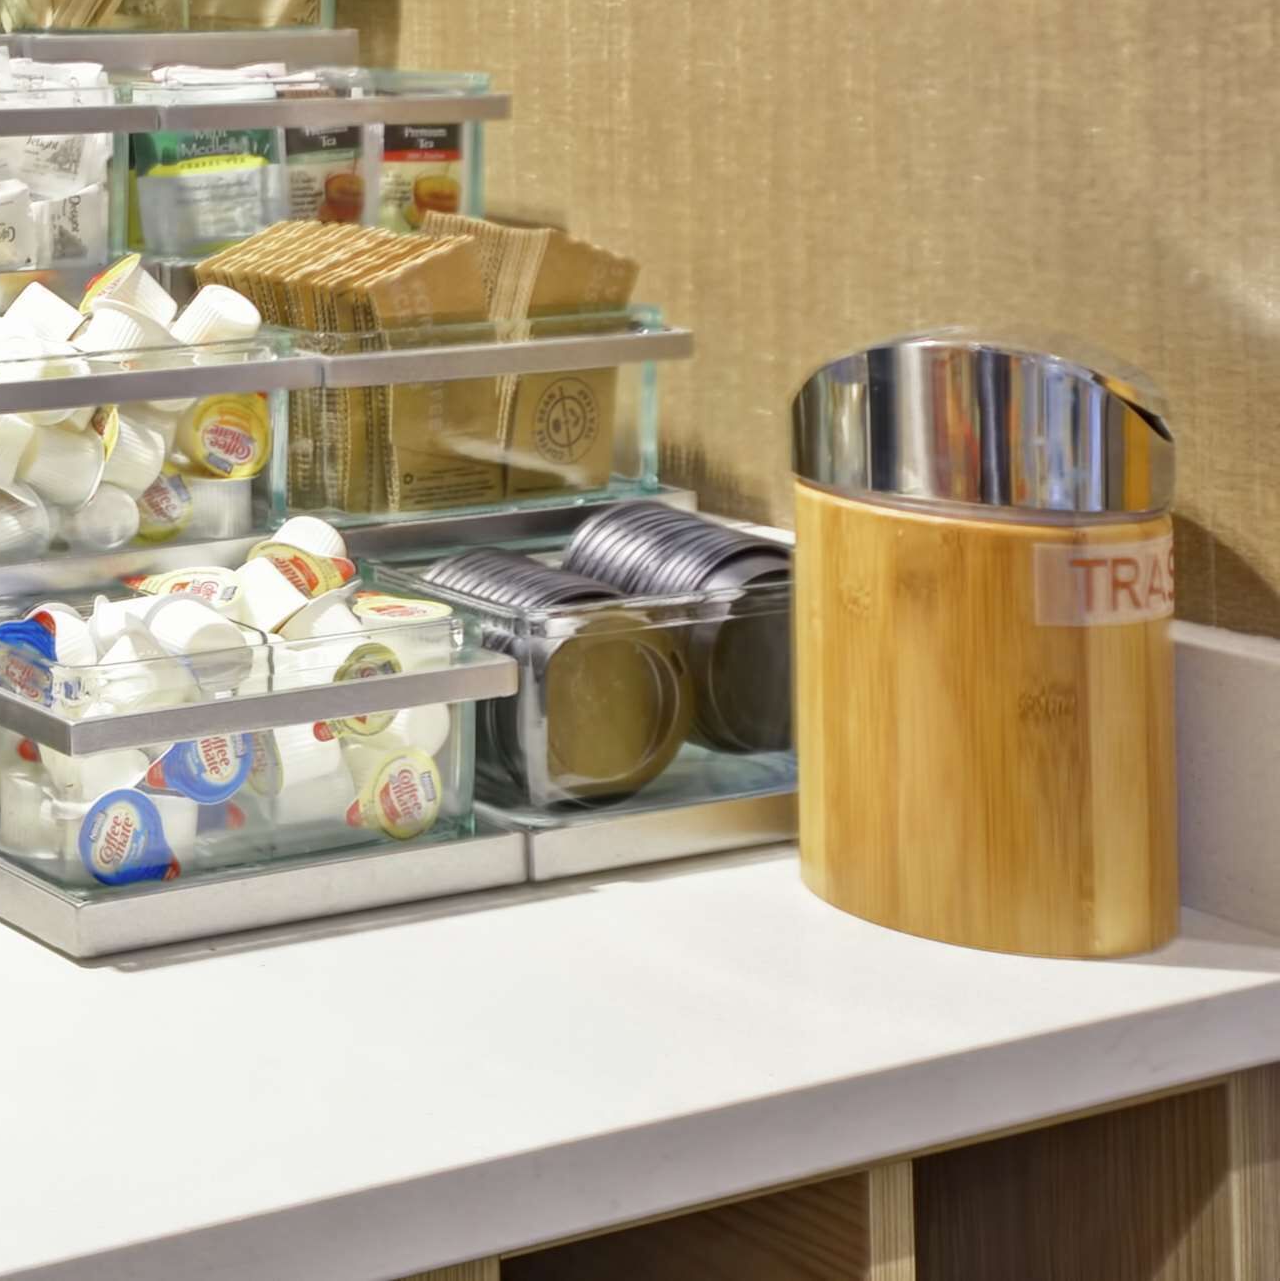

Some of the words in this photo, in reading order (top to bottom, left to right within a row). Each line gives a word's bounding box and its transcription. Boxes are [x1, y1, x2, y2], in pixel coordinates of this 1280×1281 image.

[319, 135, 337, 148] Tea
[404, 126, 447, 138] Premium
[417, 138, 434, 149] Tea
[209, 438, 251, 461] Coffee
[397, 769, 422, 811] Coffee
[98, 814, 125, 865] Coffee
[113, 816, 134, 864] mate
